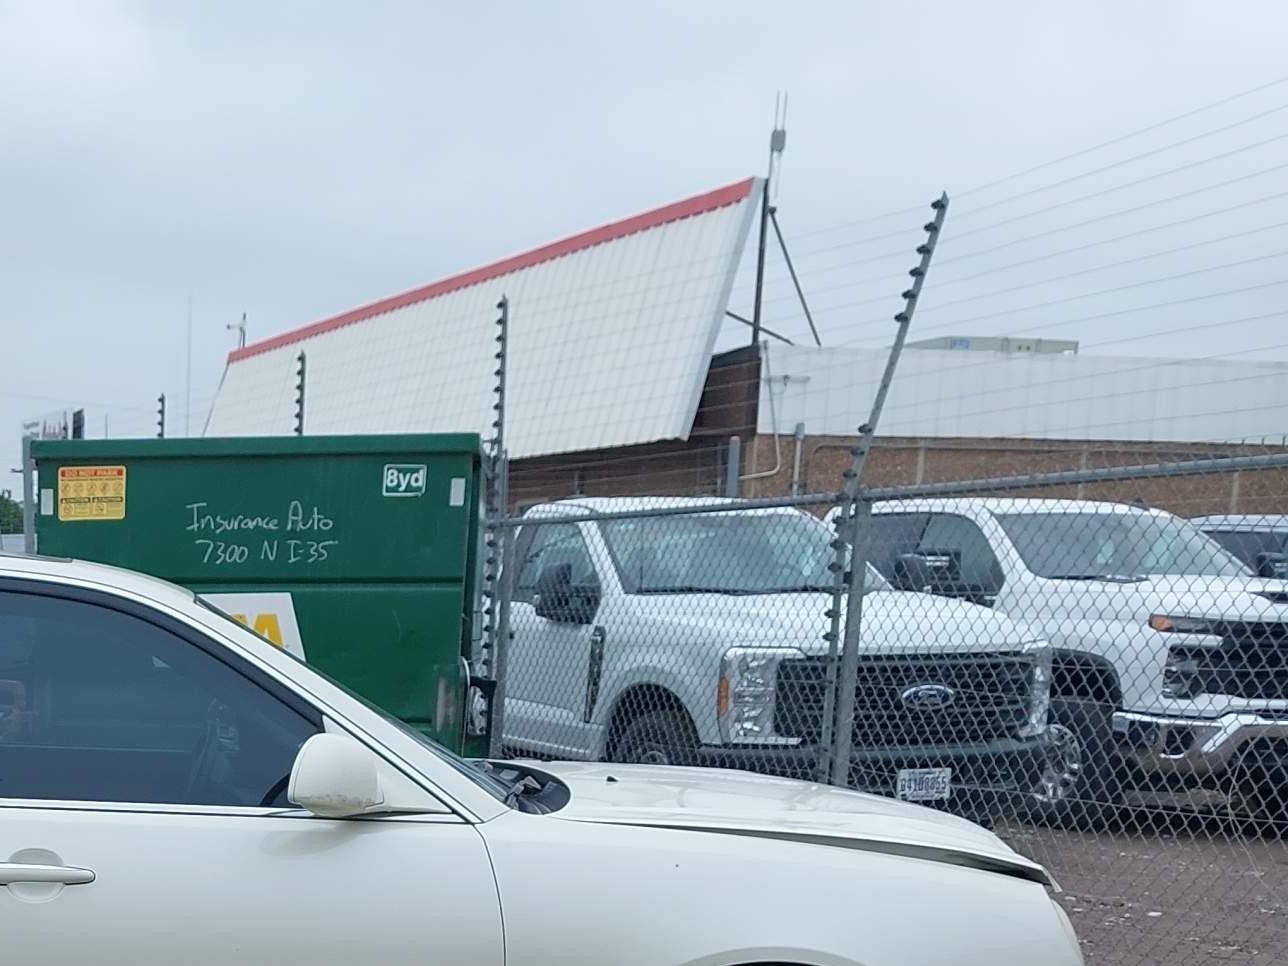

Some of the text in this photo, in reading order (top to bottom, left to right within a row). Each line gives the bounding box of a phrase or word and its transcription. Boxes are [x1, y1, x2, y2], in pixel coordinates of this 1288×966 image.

[185, 500, 334, 534] Insurance Auto
[194, 539, 339, 564] 7300 N I-35
